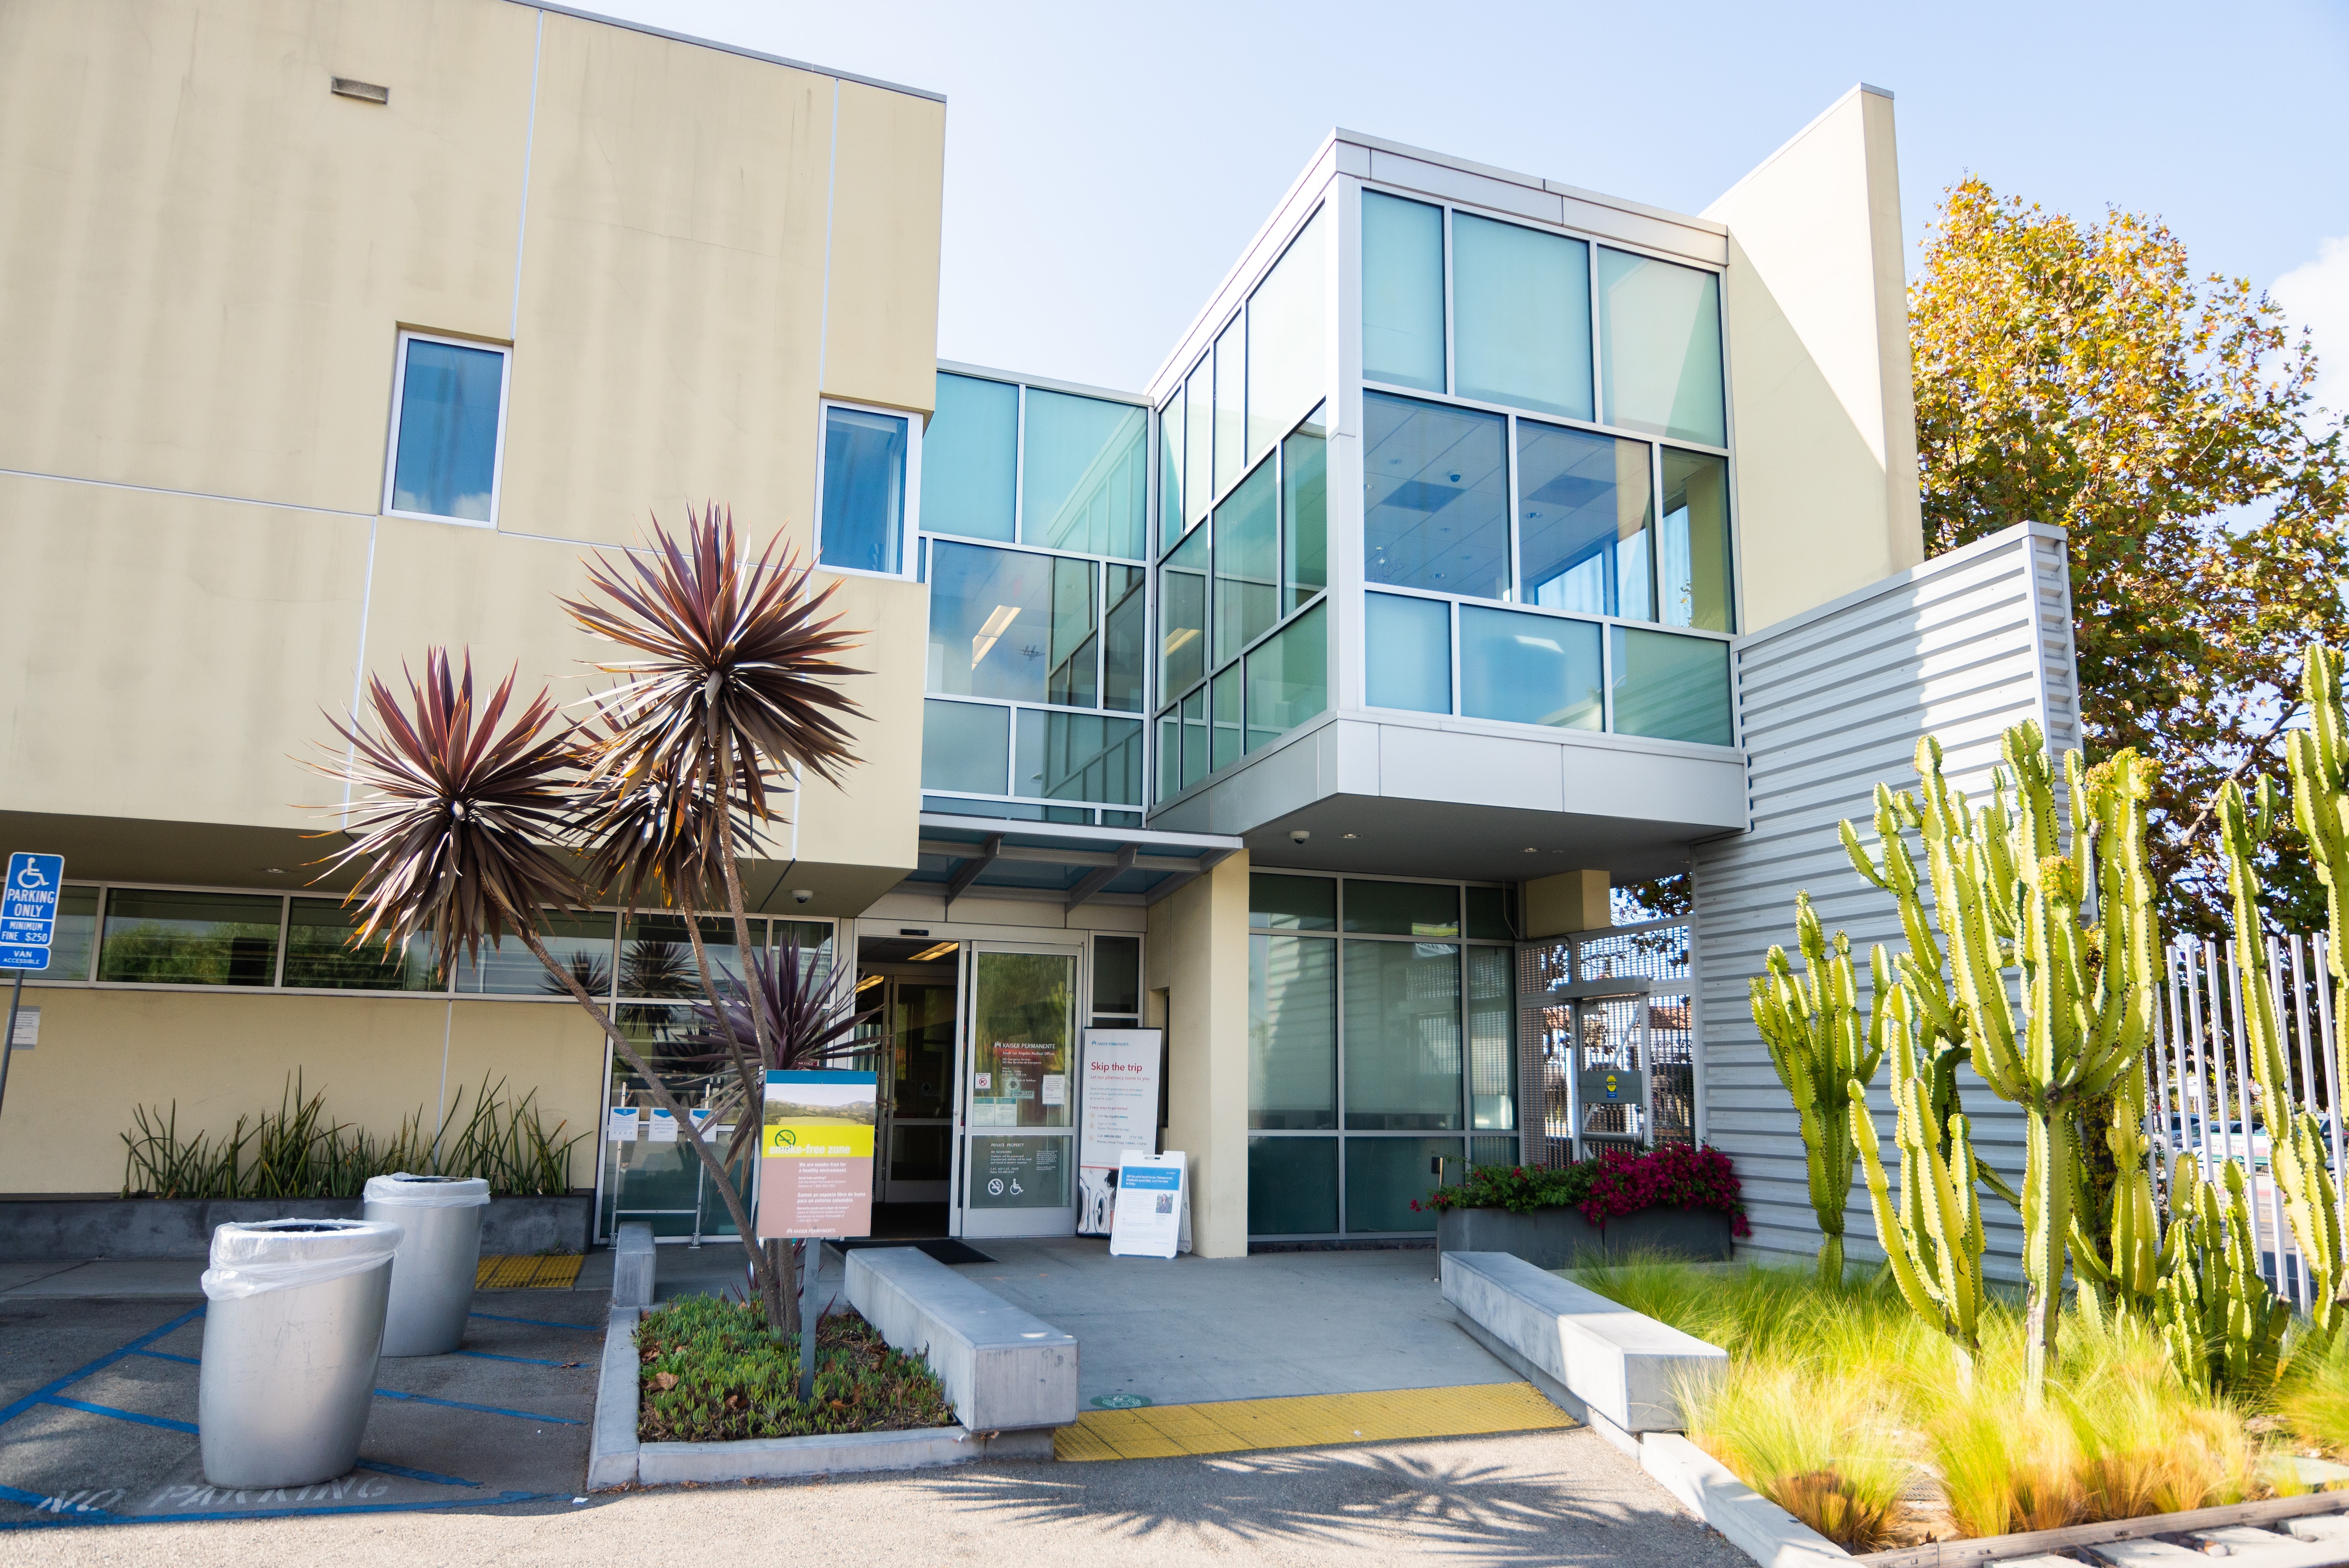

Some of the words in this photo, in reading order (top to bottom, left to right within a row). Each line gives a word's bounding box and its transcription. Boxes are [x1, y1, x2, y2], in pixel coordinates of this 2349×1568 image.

[7, 889, 55, 903] PARKING
[14, 903, 43, 917] ONLY
[9, 921, 43, 931] MINIMUM
[1, 931, 19, 940] FINE
[25, 932, 47, 942] $250
[1091, 1062, 1109, 1072] Skip
[1112, 1062, 1125, 1071] the
[1128, 1063, 1142, 1073] trip
[770, 1144, 825, 1154] smoke-free
[828, 1146, 851, 1154] zone
[30, 1489, 127, 1514] NO
[145, 1477, 391, 1508] PARKING
